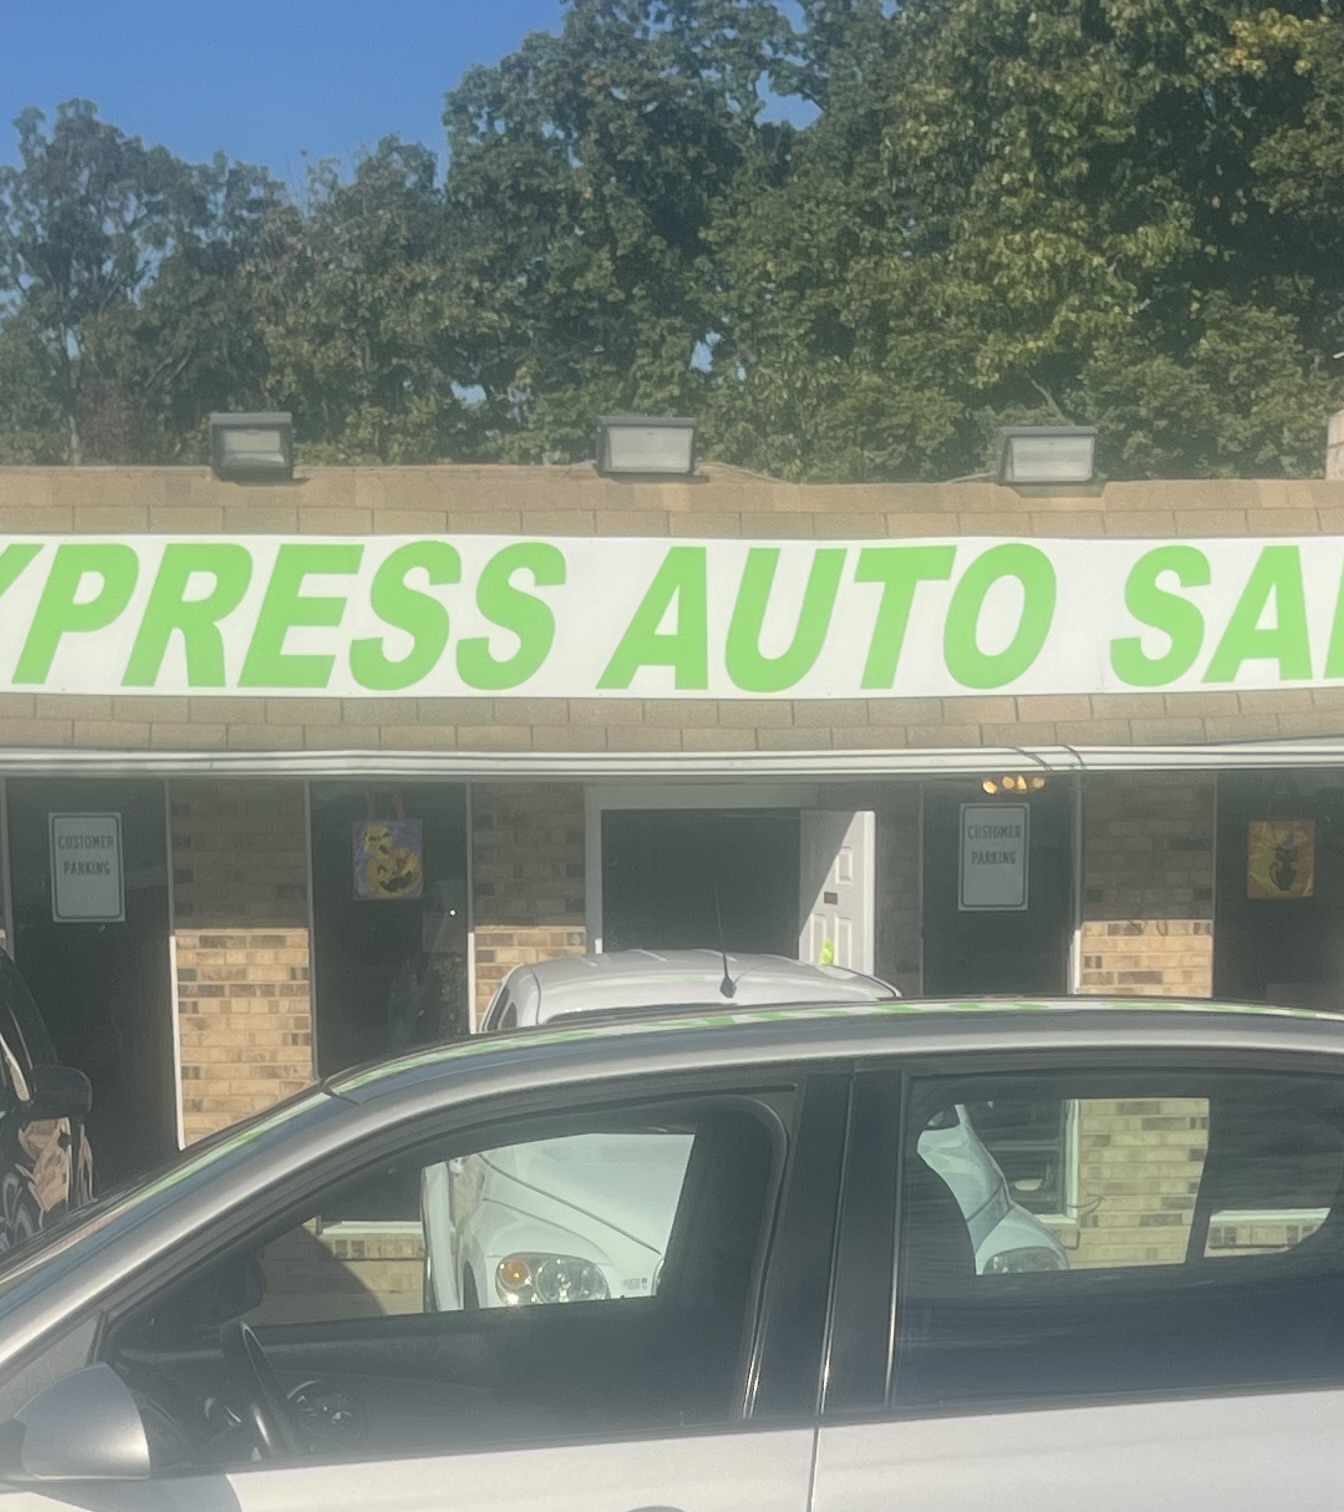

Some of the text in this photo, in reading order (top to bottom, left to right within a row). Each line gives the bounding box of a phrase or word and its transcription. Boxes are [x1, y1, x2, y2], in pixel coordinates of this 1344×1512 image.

[597, 546, 1056, 691] AUTO
[967, 825, 1022, 840] CUSTOMER
[58, 835, 115, 850] CUSTOMER
[971, 851, 1017, 865] PARKING
[63, 861, 112, 876] PARKING
